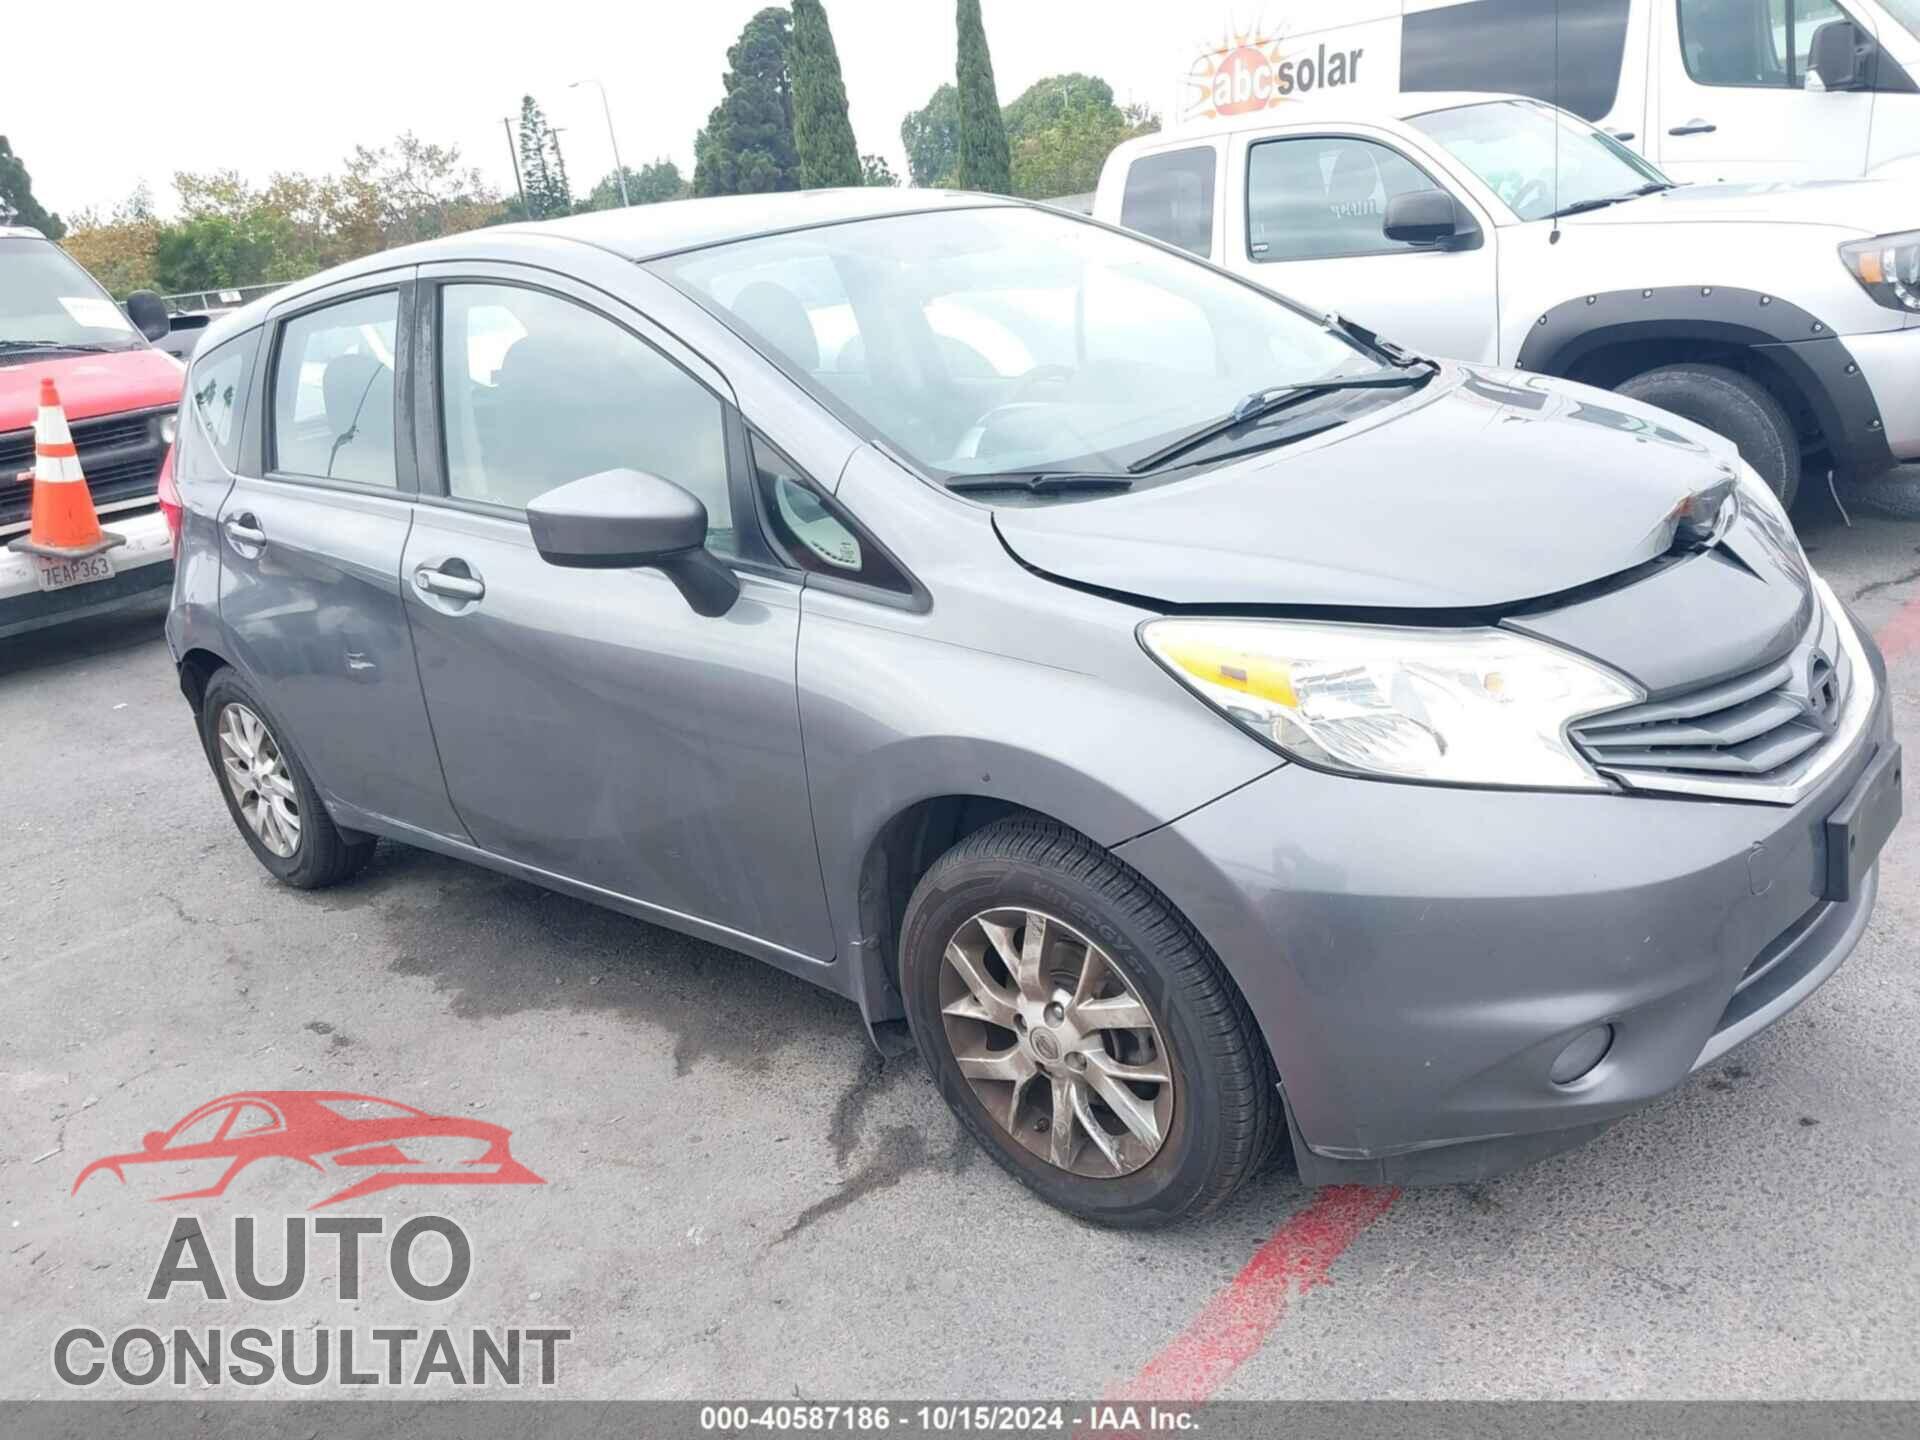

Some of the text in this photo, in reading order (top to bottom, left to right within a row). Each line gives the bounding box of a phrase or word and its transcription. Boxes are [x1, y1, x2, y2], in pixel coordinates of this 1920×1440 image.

[1214, 43, 1364, 106] abc solar
[41, 558, 109, 586] 7EAP363
